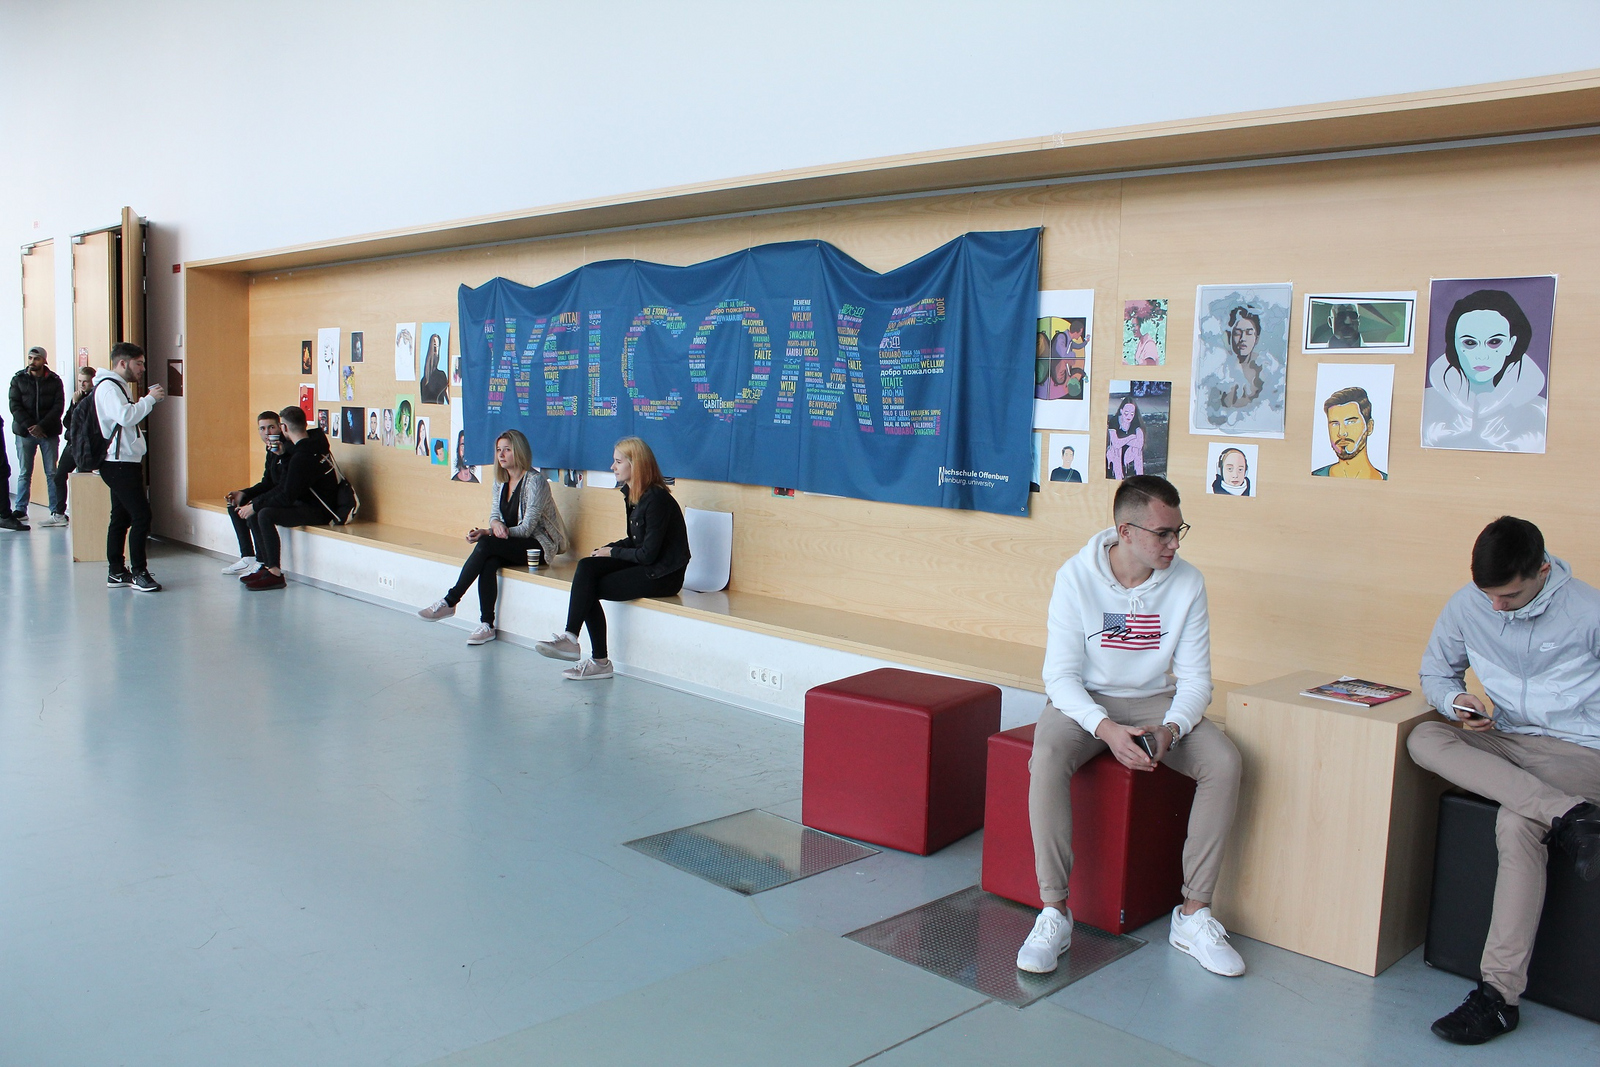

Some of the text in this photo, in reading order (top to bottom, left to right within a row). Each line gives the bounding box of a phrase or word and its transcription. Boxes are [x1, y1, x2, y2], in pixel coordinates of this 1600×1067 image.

[880, 368, 901, 377] добро
[880, 377, 904, 389] VITAJTE
[978, 470, 1009, 483] Offenburg
[967, 479, 995, 489] university
